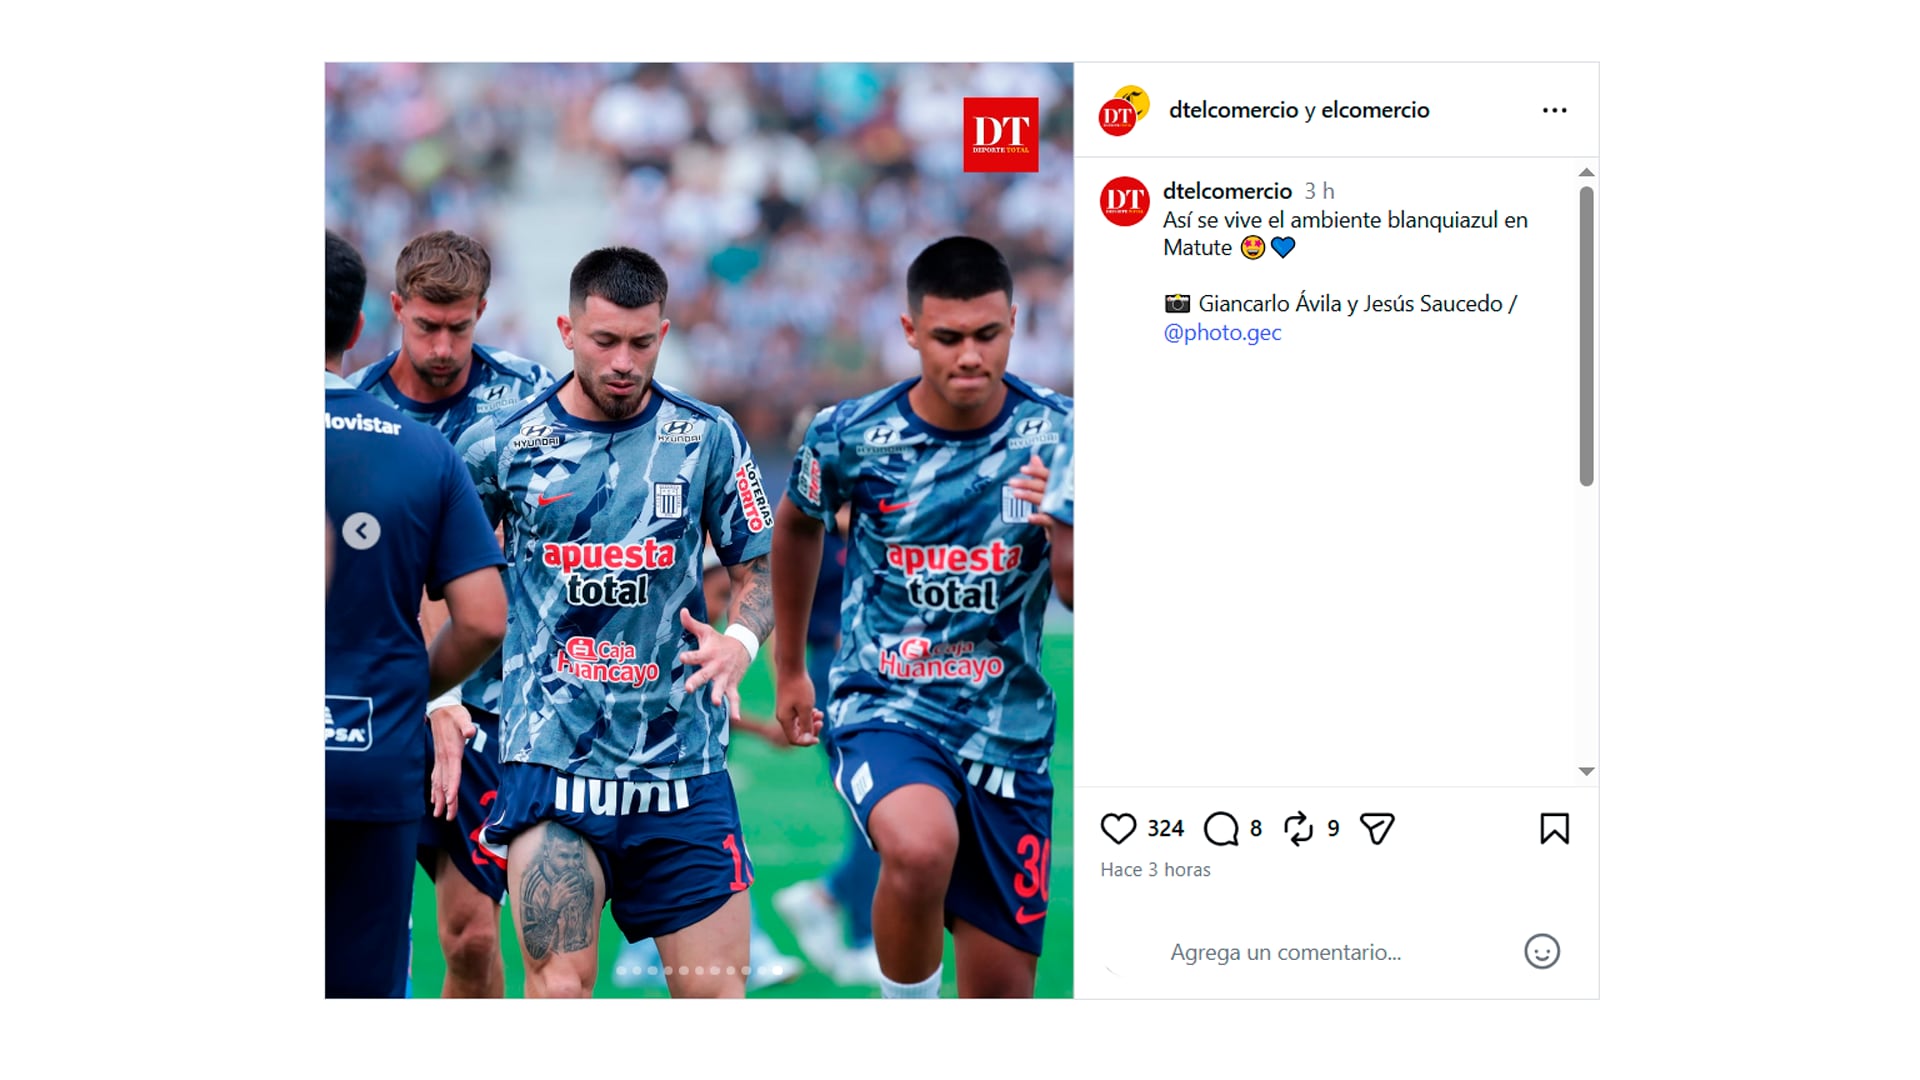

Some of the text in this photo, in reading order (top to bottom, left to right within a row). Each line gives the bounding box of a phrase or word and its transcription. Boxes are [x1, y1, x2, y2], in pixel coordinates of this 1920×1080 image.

[1103, 108, 1132, 123] DT
[1168, 99, 1431, 124] dtelcomercio y elcomercio
[1106, 189, 1145, 210] DT
[1163, 180, 1335, 200] dtelcomercio 3 h
[1162, 209, 1529, 234] Así se vive el ambiente blanquiazul en
[1163, 237, 1233, 257] Matute
[1198, 289, 1519, 318] Giancarlo Ávila y Jesús Saucedo /
[1163, 321, 1282, 346] @photo.gec
[514, 438, 559, 448] HYUNDAI
[658, 435, 701, 443] HYUNDAI
[736, 467, 763, 531] TORITO
[543, 539, 674, 573] apuesta
[887, 542, 1022, 575] apuesta
[568, 575, 647, 605] total
[909, 578, 996, 610] total
[599, 642, 635, 662] Caja
[880, 651, 1003, 683] Huancayo
[1147, 818, 1186, 838] 324
[1249, 819, 1263, 838] 8
[1327, 819, 1341, 838] 9
[722, 834, 754, 891] 1
[1101, 861, 1211, 878] Hace 3 horas
[1170, 943, 1402, 966] Agrega un comentario...
